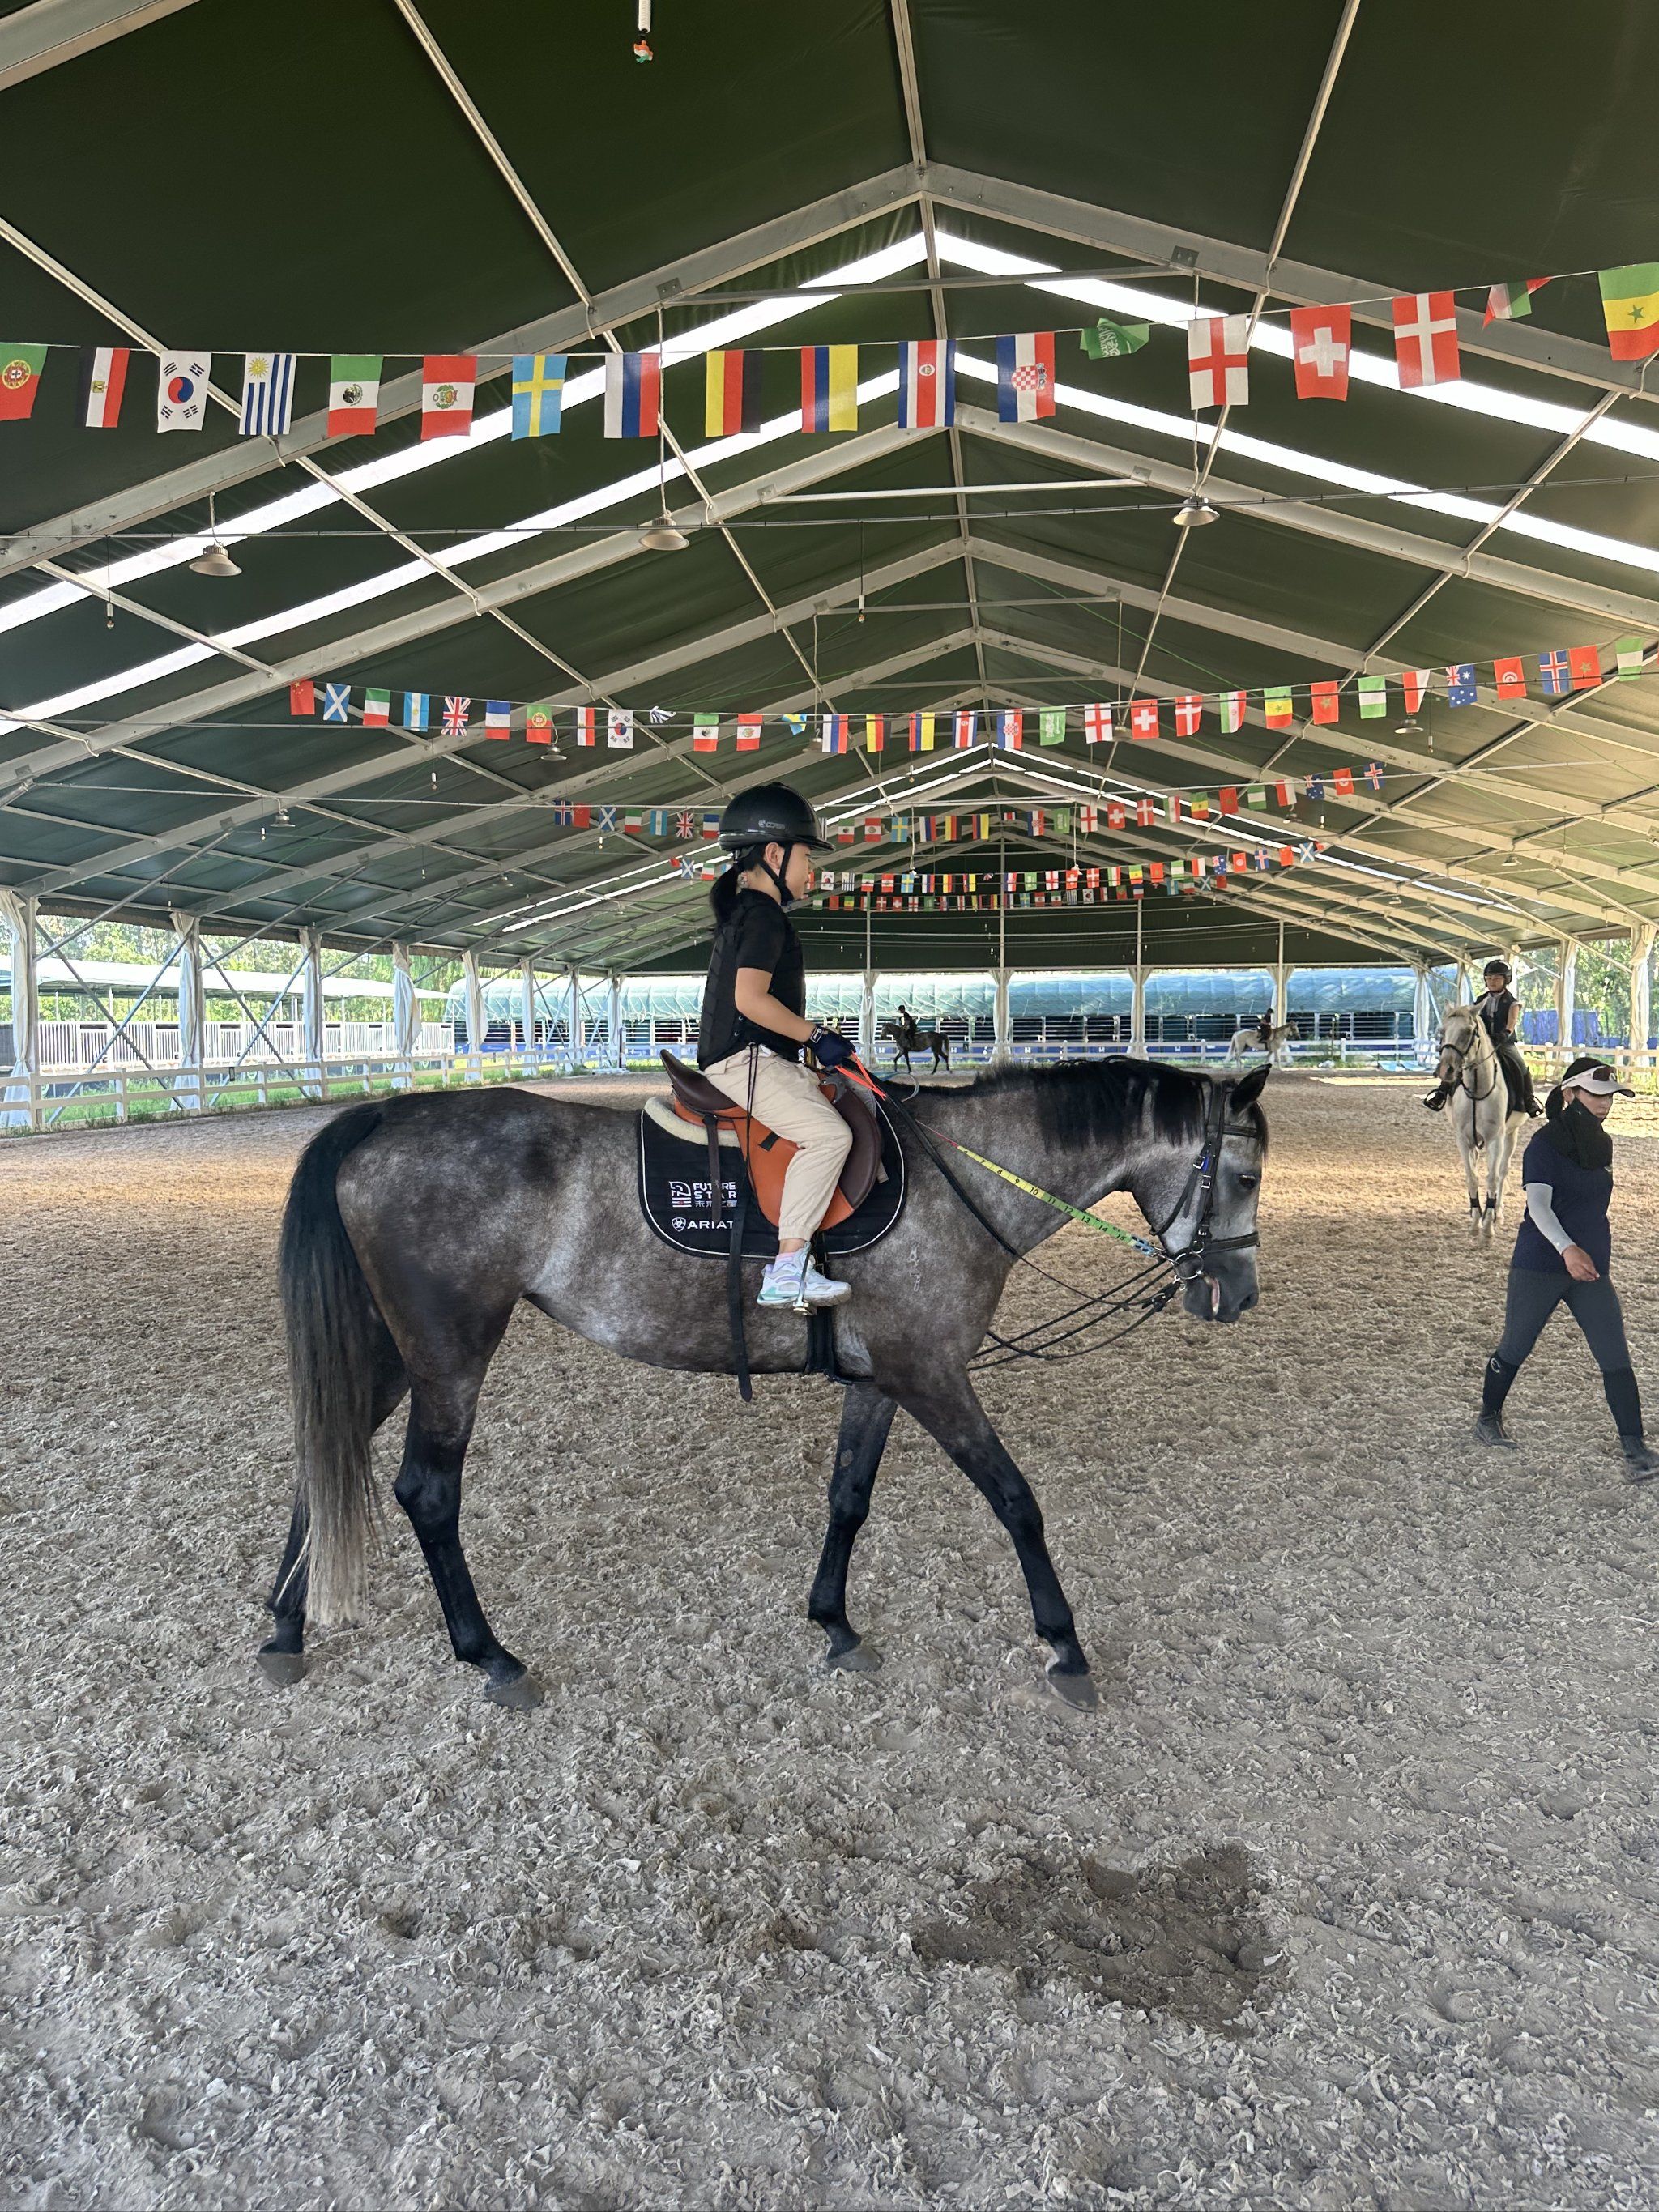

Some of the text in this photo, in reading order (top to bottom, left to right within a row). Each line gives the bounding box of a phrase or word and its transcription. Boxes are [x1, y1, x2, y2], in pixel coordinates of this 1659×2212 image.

[693, 1182, 736, 1191] FUTRE
[1030, 1187, 1038, 1195] 10
[1098, 1224, 1108, 1232] 14
[687, 1220, 733, 1229] ARIAT
